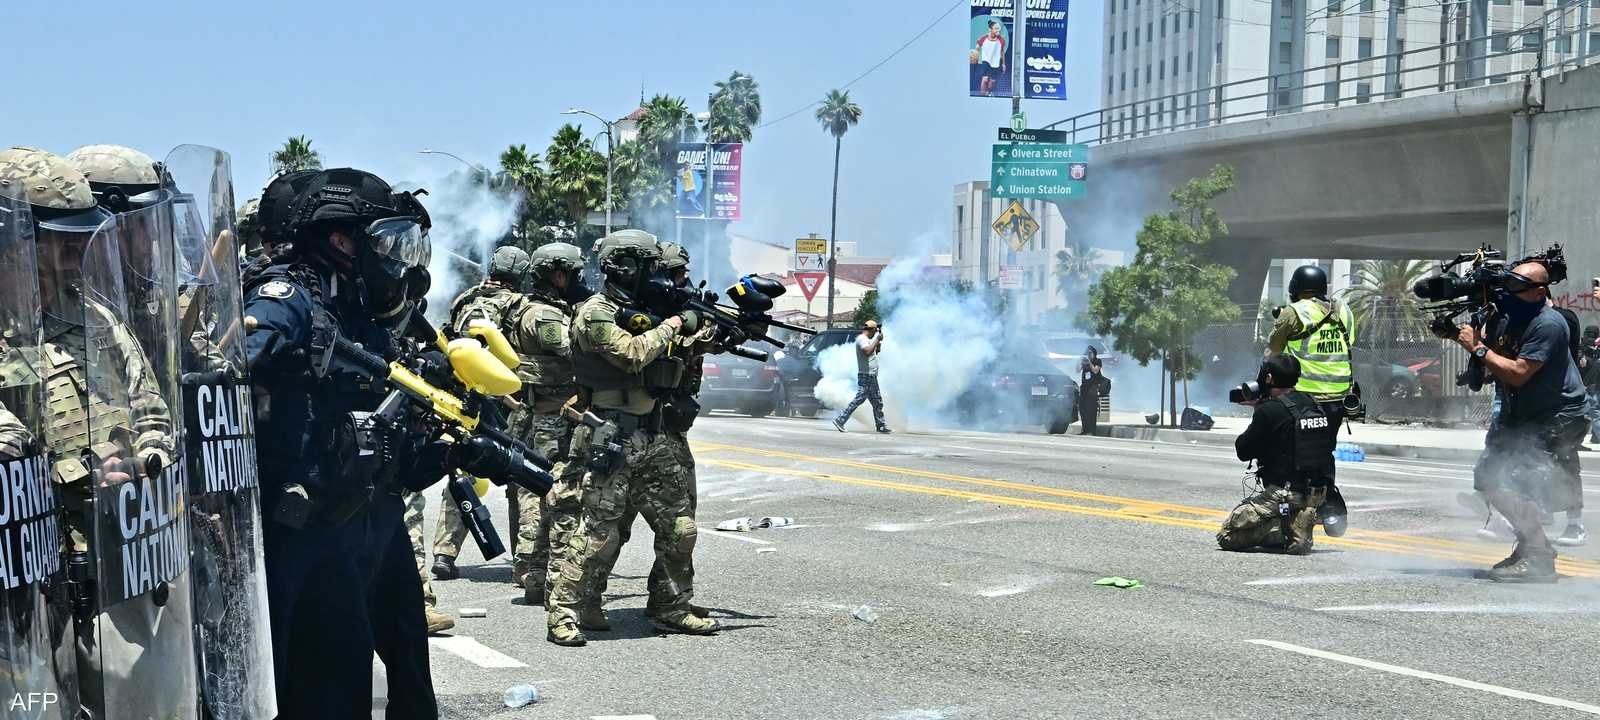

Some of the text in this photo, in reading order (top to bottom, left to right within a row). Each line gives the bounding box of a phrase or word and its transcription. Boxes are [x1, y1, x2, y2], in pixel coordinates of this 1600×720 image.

[1010, 132, 1036, 141] PUEBLO
[677, 150, 706, 164] GAME
[713, 151, 732, 164] ON!
[1011, 148, 1072, 158] Olvera Street
[1010, 167, 1058, 177] Chinatown
[1009, 185, 1071, 195] Union Station
[1316, 340, 1343, 353] MEDIA
[1300, 416, 1328, 430] PRESS
